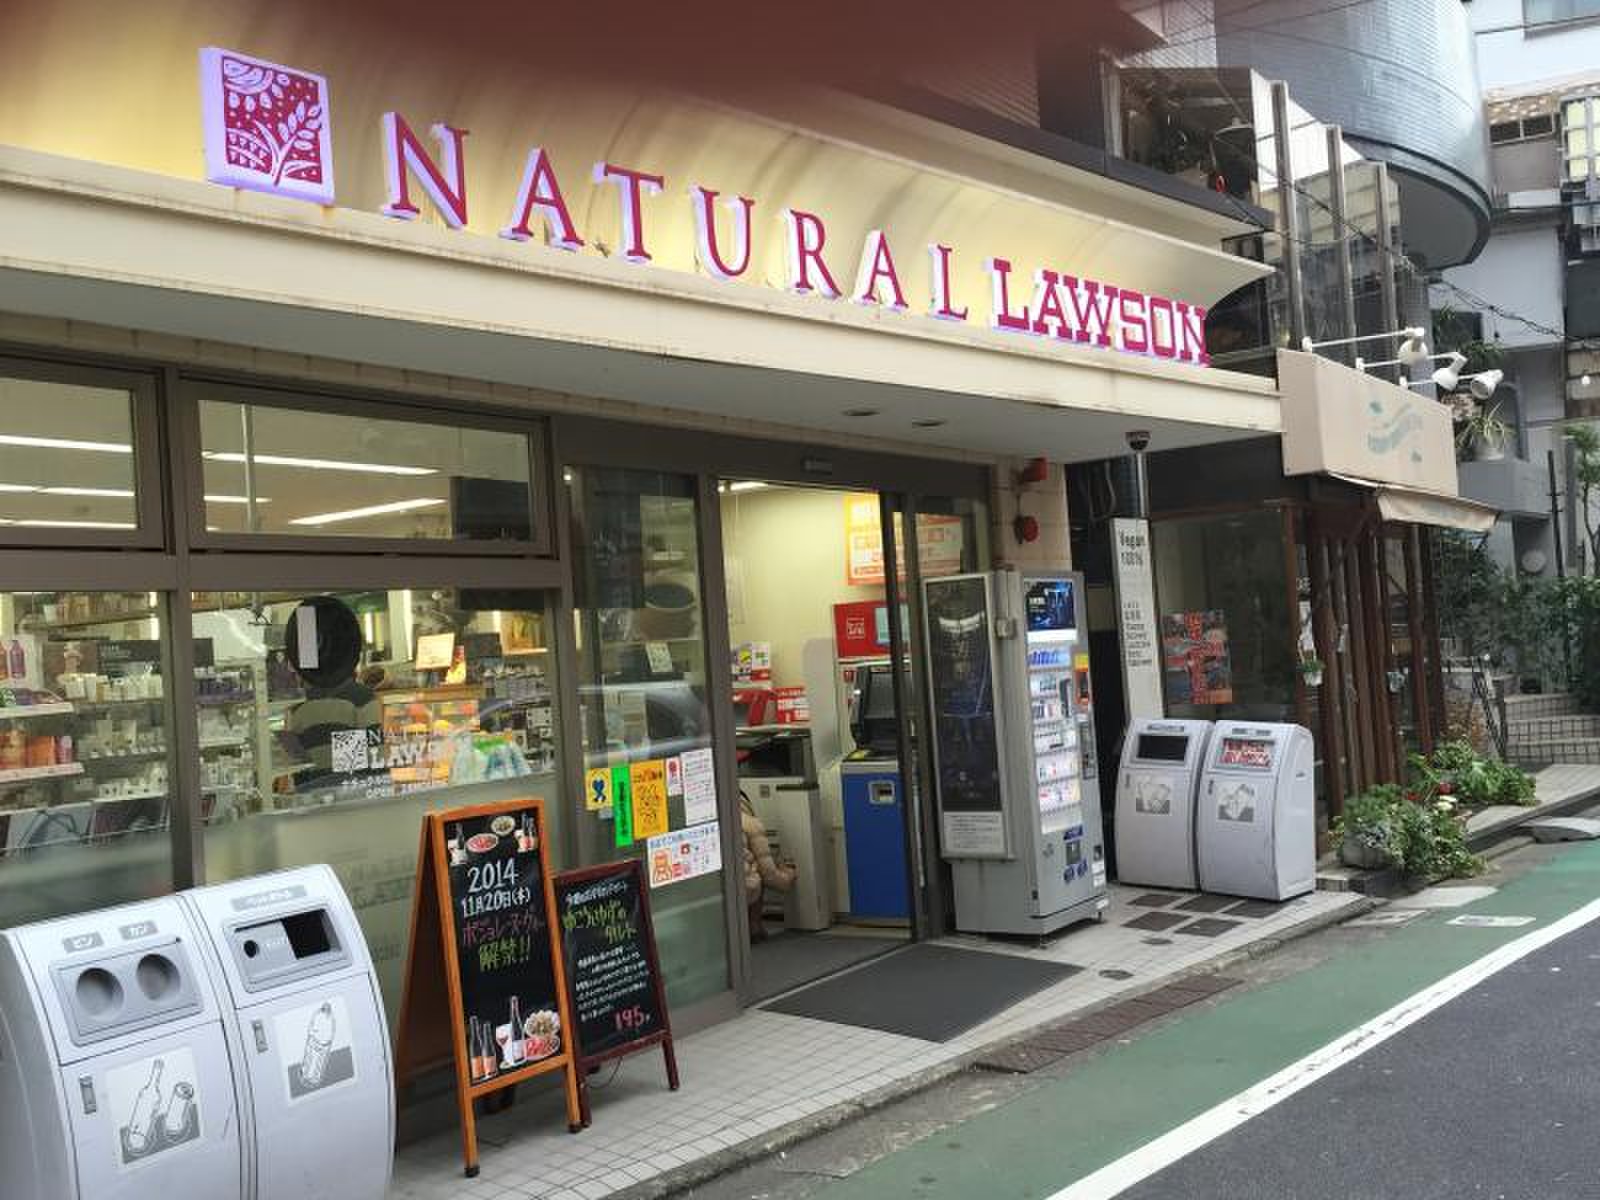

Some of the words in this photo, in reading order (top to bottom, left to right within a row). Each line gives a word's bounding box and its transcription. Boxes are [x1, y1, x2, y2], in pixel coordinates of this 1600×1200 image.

[383, 111, 968, 322] NATURAL
[984, 257, 1211, 367] LAWSON
[1119, 530, 1146, 550] Vegan
[1120, 552, 1144, 566] 100%
[467, 857, 519, 893] 2014
[461, 886, 531, 919] 11月20日(木)
